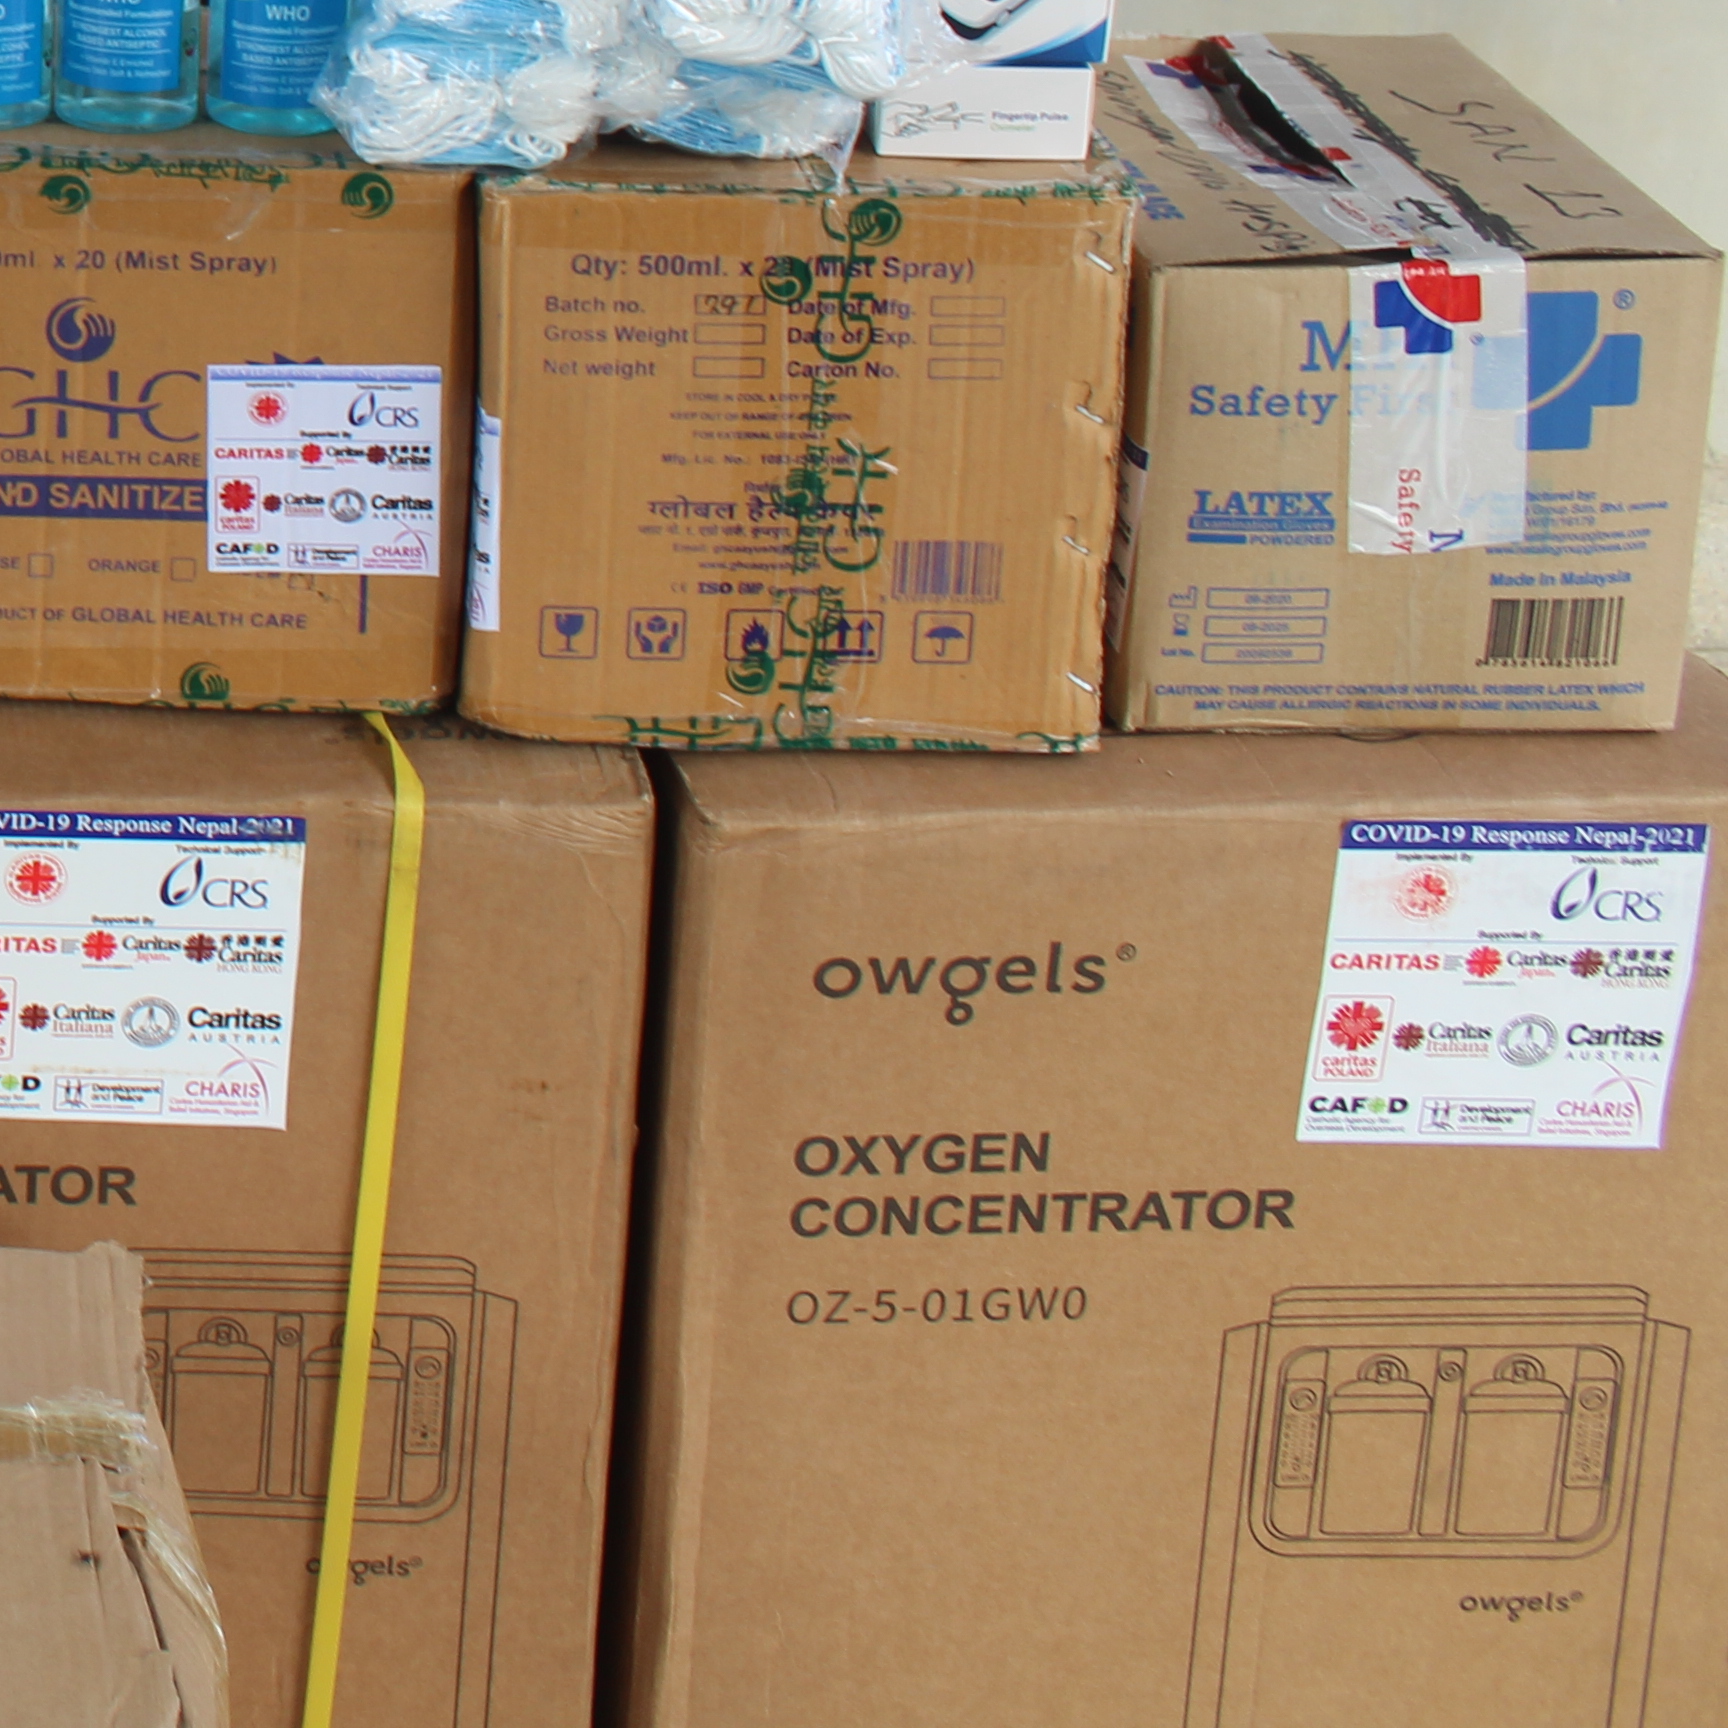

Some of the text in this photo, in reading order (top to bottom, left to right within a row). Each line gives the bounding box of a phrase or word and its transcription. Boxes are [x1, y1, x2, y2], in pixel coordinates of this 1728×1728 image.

[544, 325, 688, 346] Gross Weight
[545, 359, 655, 379] Net weight
[62, 450, 139, 466] HEALTH
[143, 451, 203, 467] CARE
[49, 482, 205, 512] SANITIZE
[648, 493, 736, 521] ग्लोबल
[1194, 490, 1334, 516] LATEX
[1396, 467, 1422, 554] Safety
[1249, 534, 1335, 545] POWDERED
[88, 557, 162, 573] ORANGE
[77, 816, 171, 835] Response
[178, 817, 295, 836] Nepal-2021
[1351, 824, 1695, 848] COVID-19 Response Nepal-2021
[202, 879, 269, 909] CRS
[1330, 953, 1439, 970] CARITAS
[812, 941, 1108, 1025] owgels
[53, 1004, 115, 1021] Caritas
[187, 1007, 282, 1031] Caritas
[185, 1080, 260, 1098] CHARIS
[794, 1131, 1051, 1177] OXYGEN
[789, 1188, 1295, 1238] CONCENTRATOR
[786, 1284, 1089, 1327] OZ-5-01GW0
[1459, 1590, 1570, 1622] owgels
